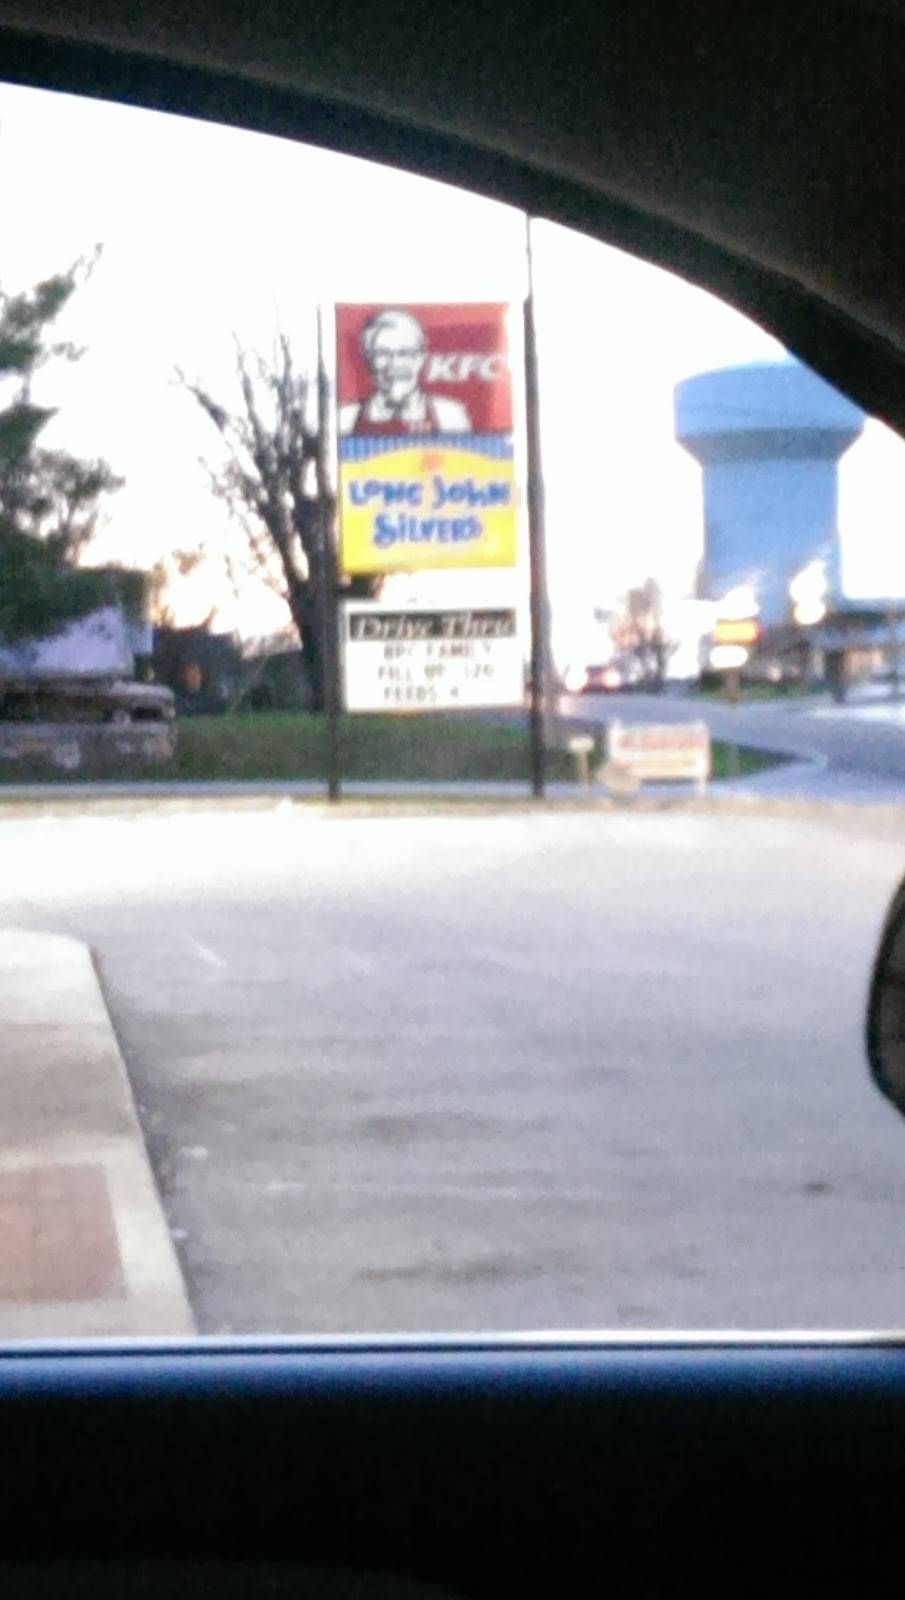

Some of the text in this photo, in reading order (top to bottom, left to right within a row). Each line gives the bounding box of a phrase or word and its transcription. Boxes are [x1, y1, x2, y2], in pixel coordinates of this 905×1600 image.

[427, 353, 504, 382] KFC
[356, 611, 514, 640] Drive Thru
